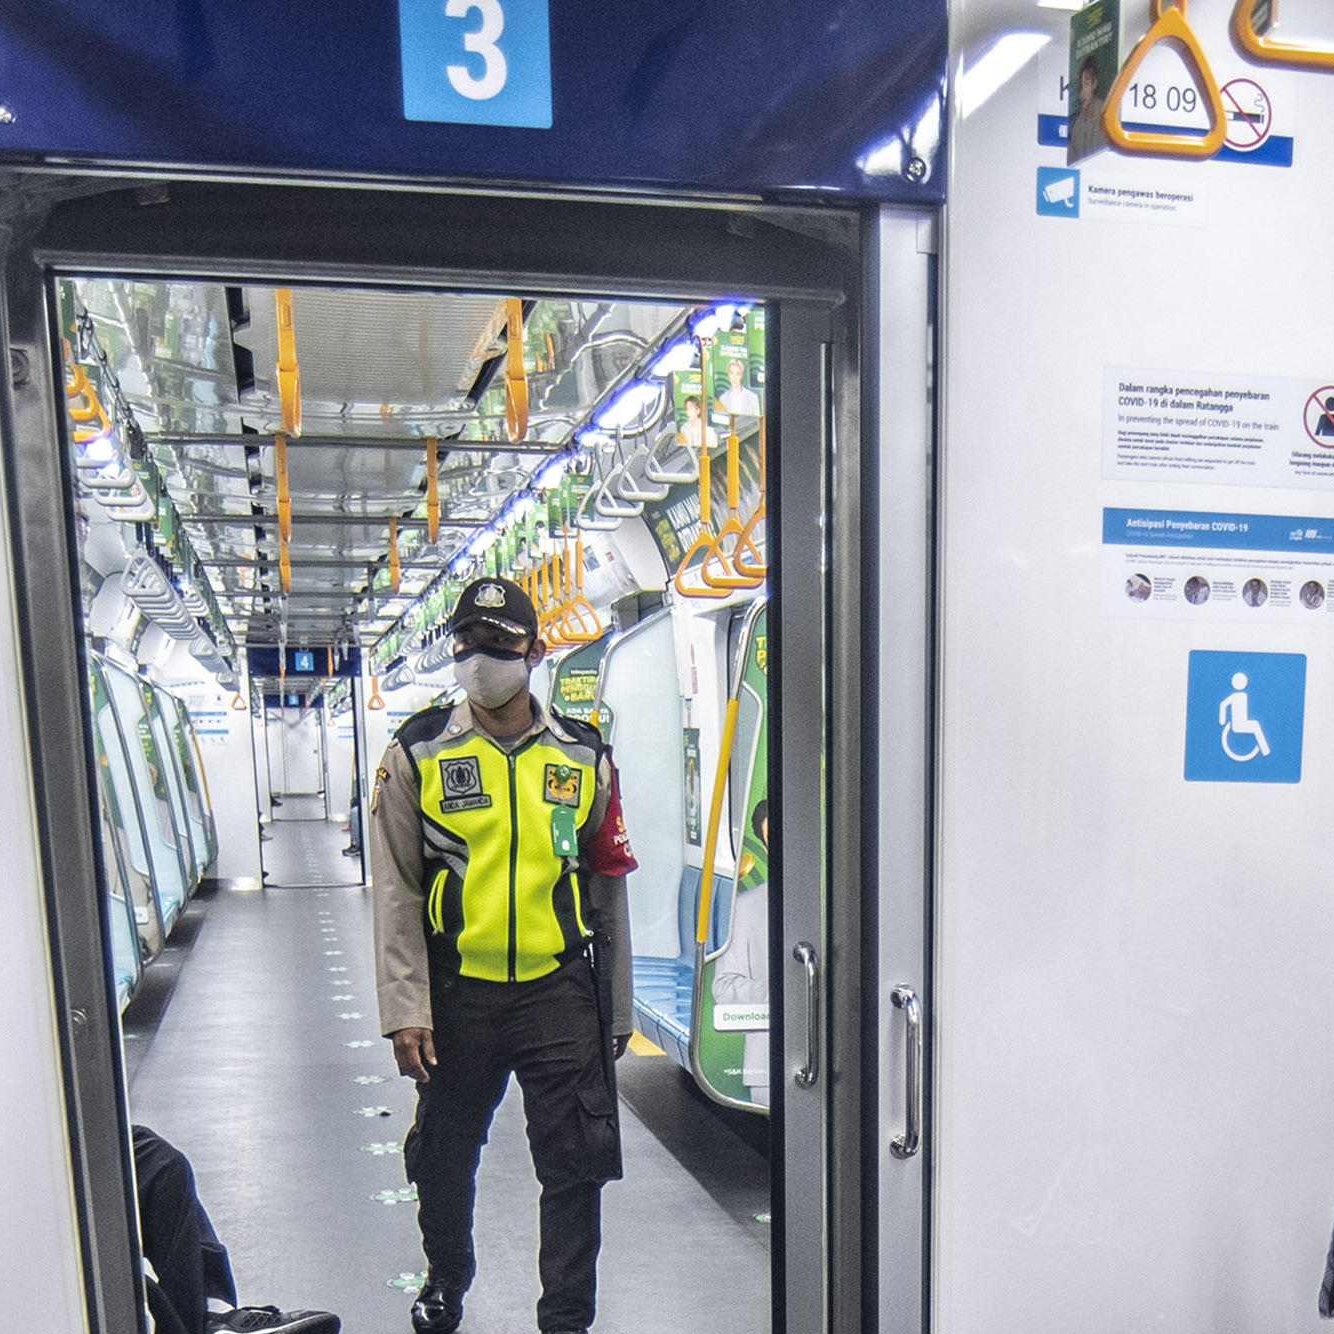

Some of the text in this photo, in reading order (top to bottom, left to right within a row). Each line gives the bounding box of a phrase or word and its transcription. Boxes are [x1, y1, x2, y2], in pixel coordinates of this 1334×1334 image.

[445, 0, 507, 100] 3
[1129, 83, 1157, 109] 18
[1167, 86, 1197, 113] 09
[1088, 185, 1194, 202] Kamera pengawas beroperasi
[1119, 383, 1270, 401] Dalam rangka pencegahan penyebaran
[1118, 397, 1233, 414] COVID-19 di dalam Ratangga
[1118, 414, 1124, 422] In
[1126, 415, 1161, 426] preventing
[1163, 416, 1173, 425] the
[1175, 418, 1198, 427] spread
[1207, 419, 1240, 429] COVID-19
[1126, 518, 1248, 533] Antisipasi Penyebaran COVID-19
[300, 655, 309, 669] 4
